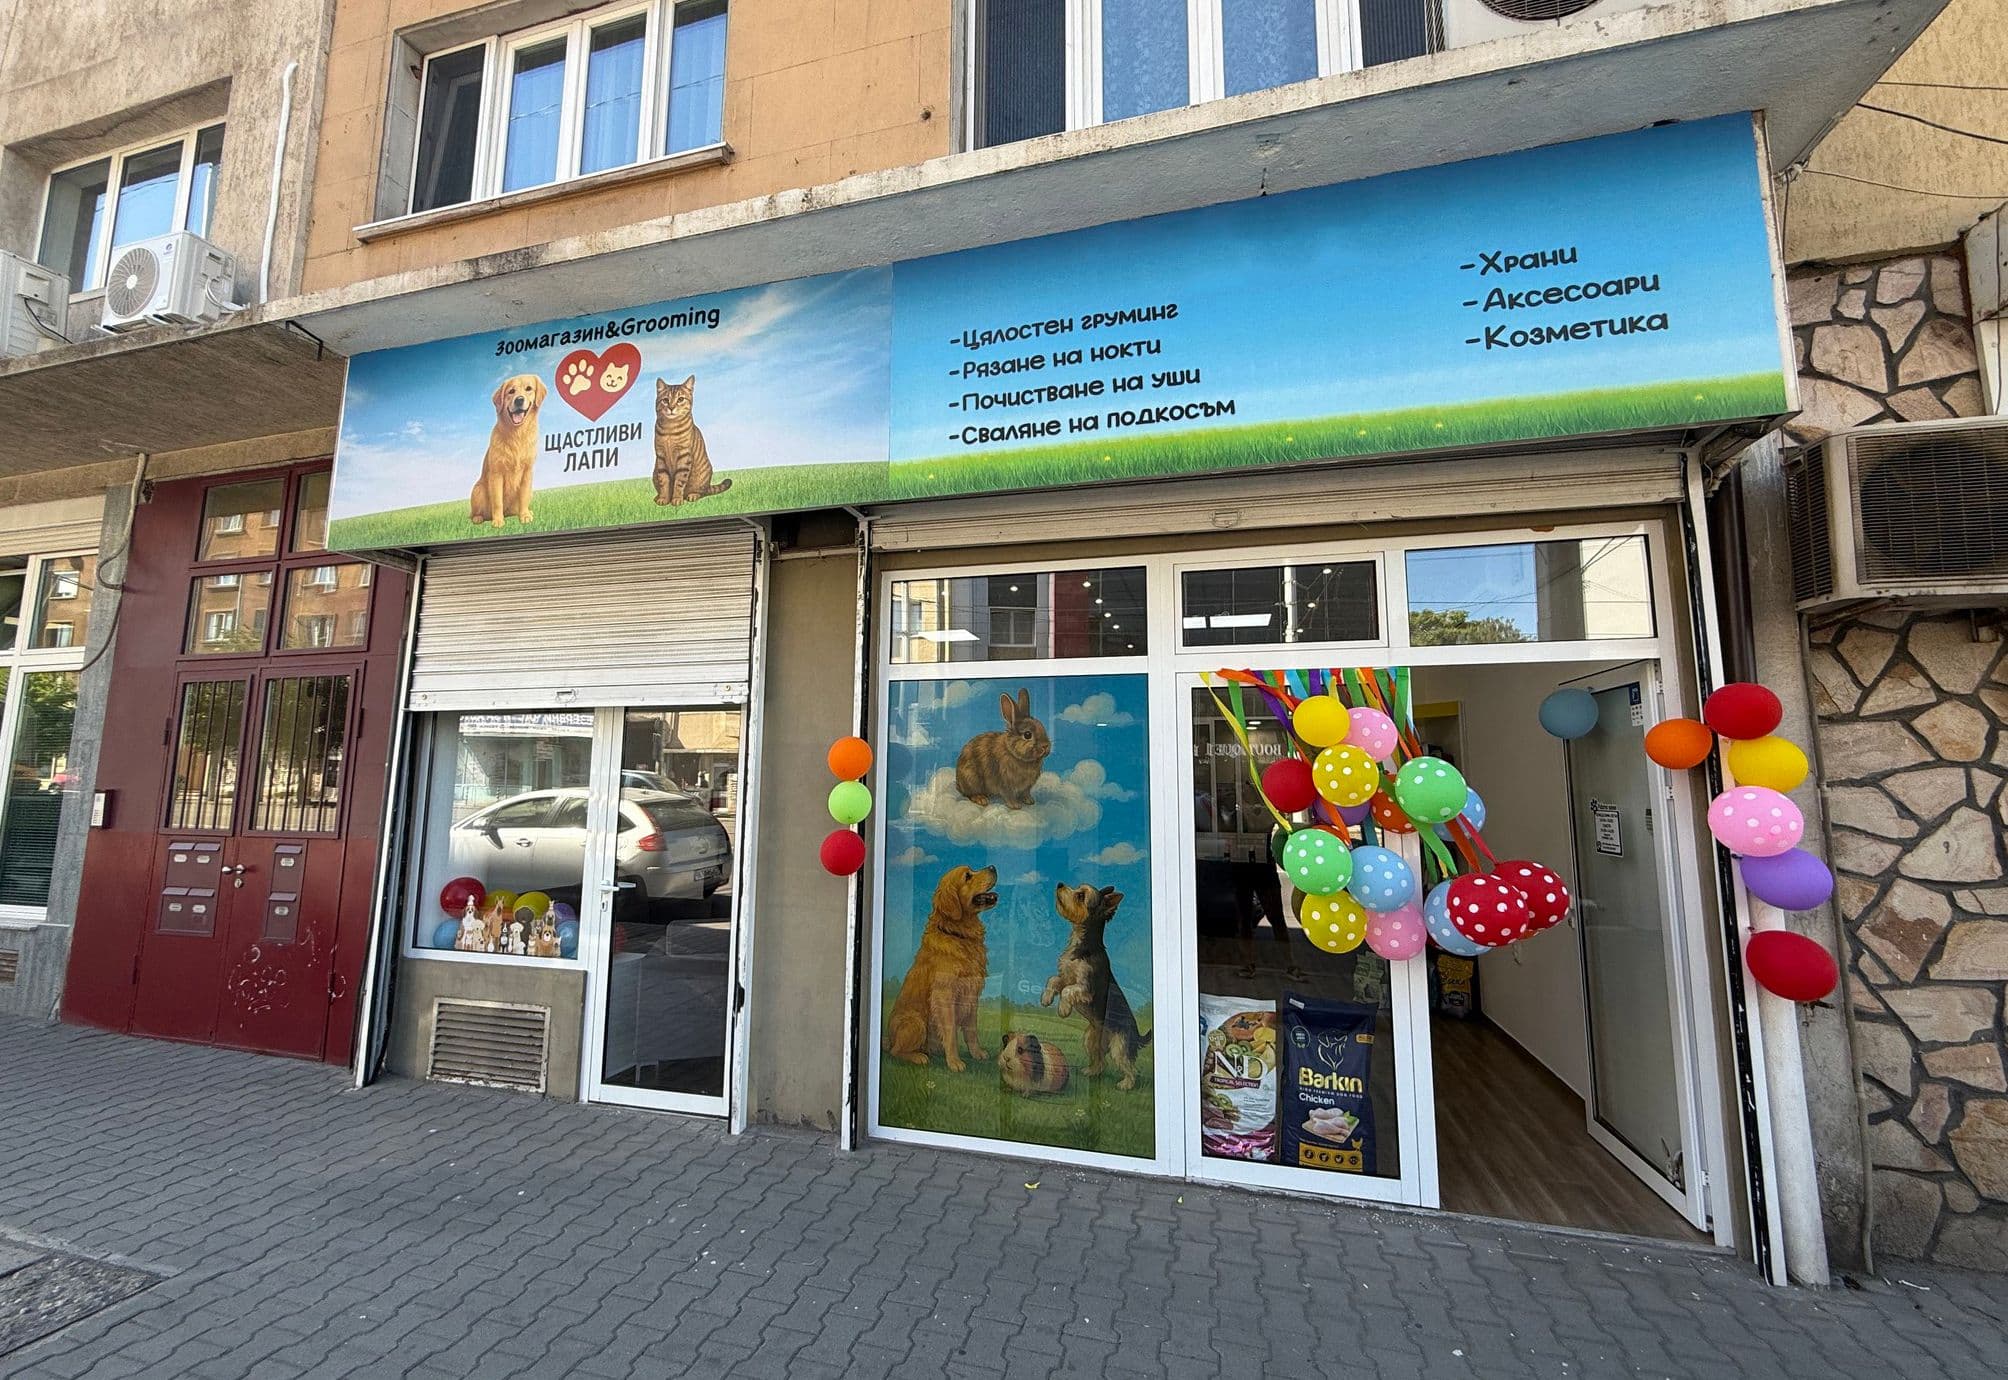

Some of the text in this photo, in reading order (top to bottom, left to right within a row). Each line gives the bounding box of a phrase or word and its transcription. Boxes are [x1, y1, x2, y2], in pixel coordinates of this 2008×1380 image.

[1080, 303, 1179, 331] груминг
[1052, 349, 1083, 368] на
[1090, 338, 1162, 363] нокти
[1112, 374, 1144, 394] на
[1151, 367, 1201, 388] уши
[1068, 414, 1099, 434] на
[1107, 399, 1236, 428] подкосъм
[545, 422, 643, 454] ЩАСТЛИВИ
[563, 446, 619, 473] ЛАПИ
[1298, 1066, 1363, 1093] Barkin
[1298, 1091, 1336, 1106] Chicken
